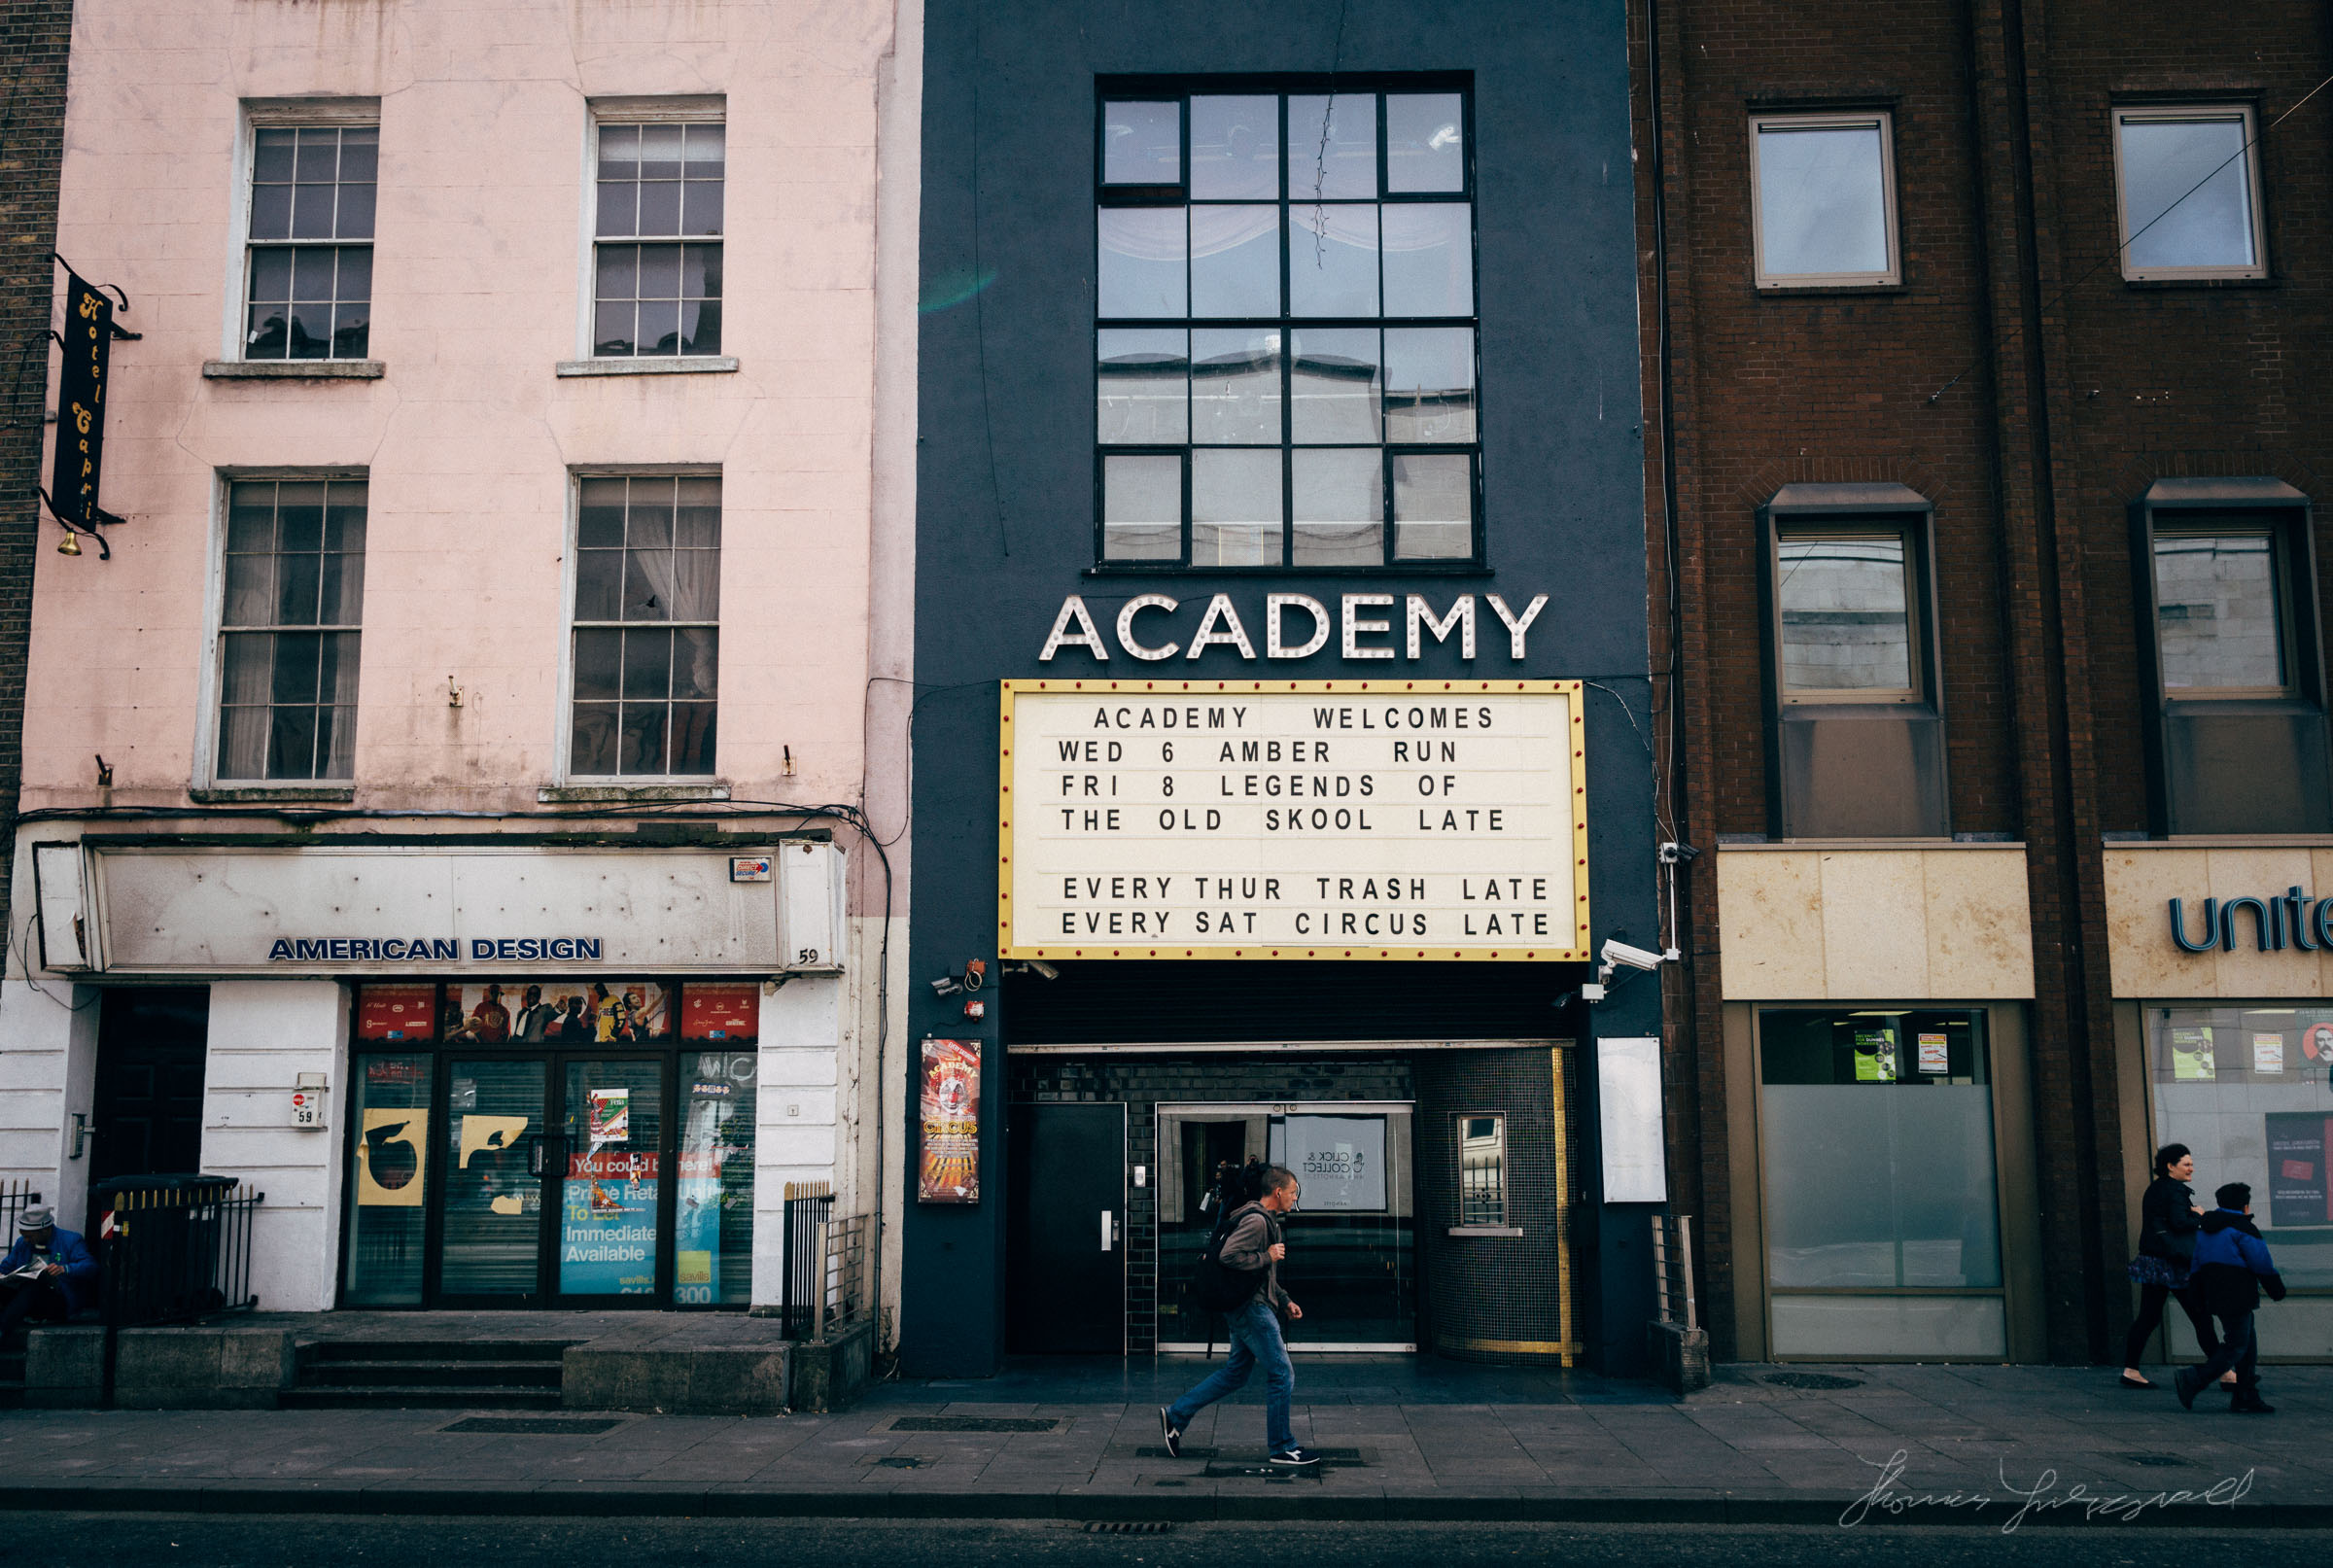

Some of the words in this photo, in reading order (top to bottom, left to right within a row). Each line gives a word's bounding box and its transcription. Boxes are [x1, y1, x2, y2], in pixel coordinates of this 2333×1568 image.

[79, 292, 104, 403] Hotel
[72, 401, 92, 521] Capri
[1038, 593, 1549, 661] ACADEMY
[1094, 707, 1248, 729] ACADEMY
[1313, 707, 1493, 729] WELCOMES
[1059, 741, 1123, 763] WED
[1162, 741, 1174, 763] 6
[1219, 741, 1331, 763] AMBER
[1394, 741, 1456, 763] RUN
[1062, 775, 1118, 796] FRI
[1163, 776, 1175, 797] 8
[1222, 774, 1375, 797] LEGENDS
[1418, 775, 1456, 796] OF
[1061, 809, 1121, 831] THE
[1159, 809, 1222, 831] OLD
[1266, 808, 1373, 831] SKOOL
[1419, 809, 1504, 831] LATE
[1063, 877, 1172, 900] EVERY
[1195, 877, 1281, 900] THUR
[1316, 878, 1426, 900] TRASH
[1463, 878, 1548, 900] LATE
[1062, 911, 1170, 934] EVERY
[1196, 911, 1258, 934] SAT
[1295, 912, 1428, 935] CIRCUS
[1464, 913, 1549, 935] LATE
[267, 937, 460, 961] AMERICAN
[471, 937, 602, 960] DESIGN
[799, 948, 818, 964] 59
[928, 1060, 978, 1079] ACADEMY
[298, 1111, 312, 1123] 59
[923, 1121, 978, 1134] CIRCUS
[575, 1159, 603, 1172] You
[607, 1159, 649, 1172] coud
[568, 1184, 620, 1201] Prie
[568, 1205, 588, 1221] To
[565, 1245, 645, 1262] Available
[679, 1272, 710, 1282] savills
